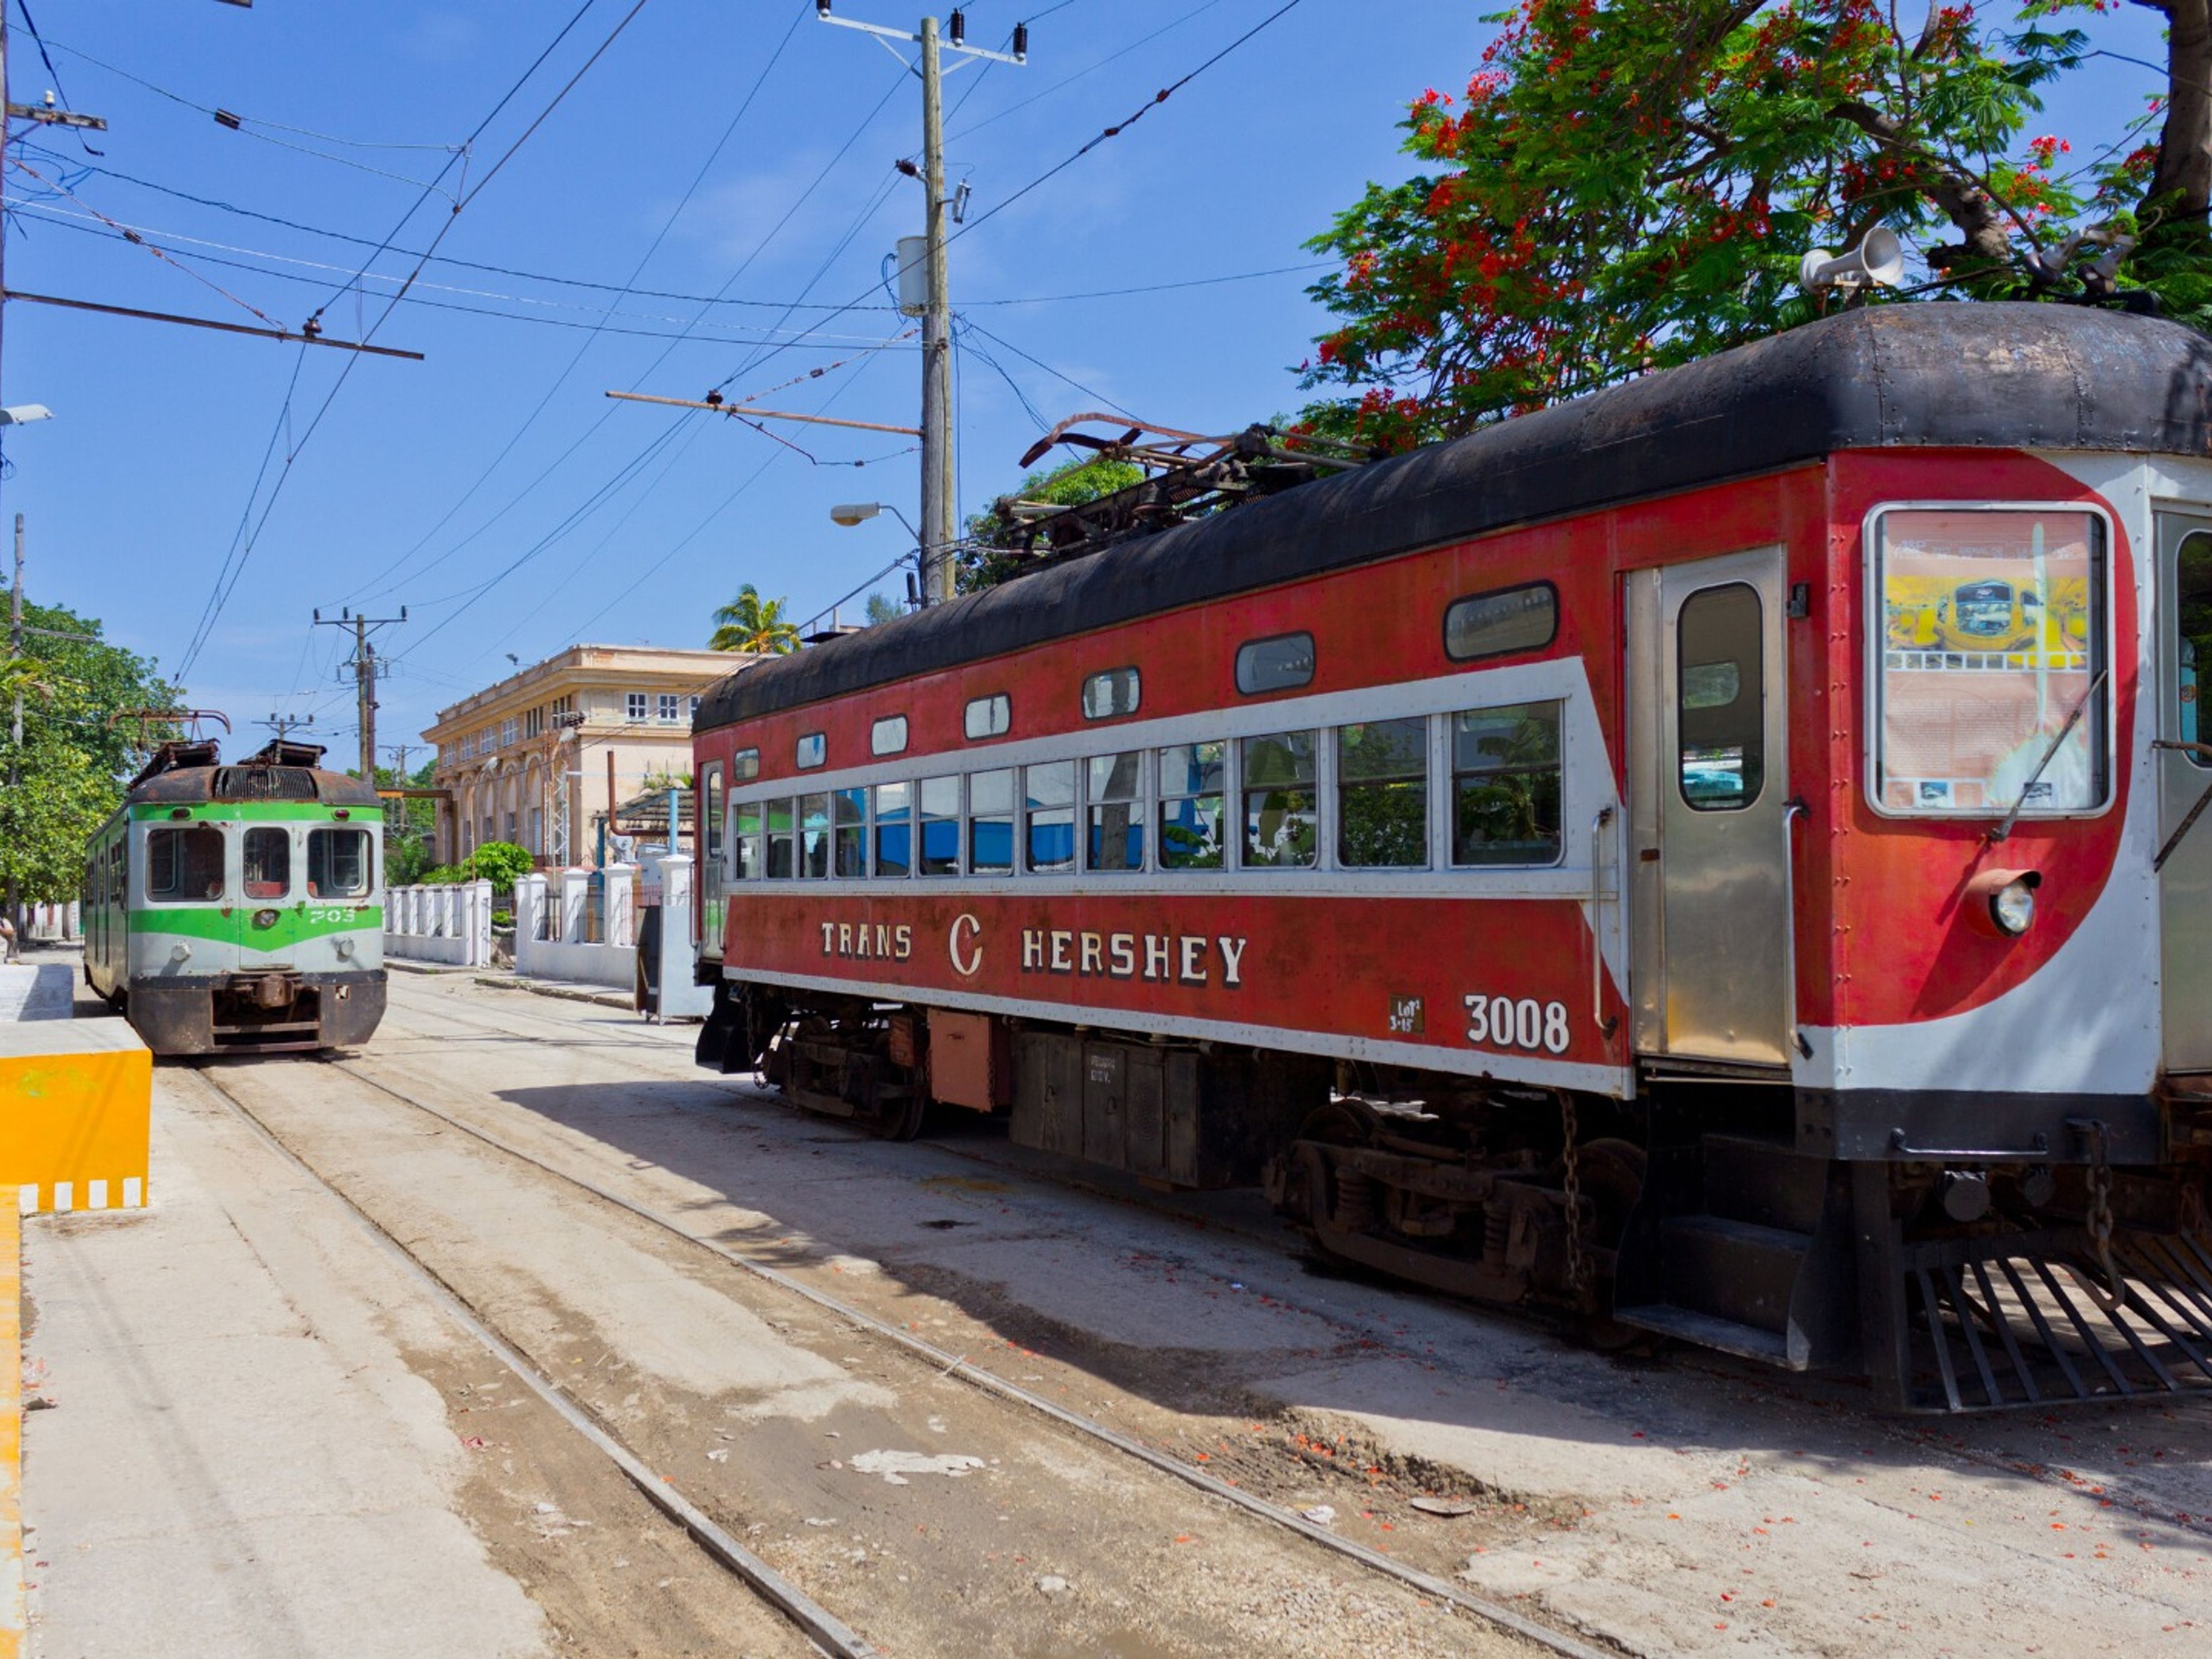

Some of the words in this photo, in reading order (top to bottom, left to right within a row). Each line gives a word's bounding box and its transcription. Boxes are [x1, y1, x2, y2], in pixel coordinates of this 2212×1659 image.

[310, 910, 355, 923] 203
[822, 922, 911, 960] TRANS
[949, 914, 983, 976] C
[1022, 930, 1246, 986] HERSHEY
[1464, 994, 1570, 1054] 3008
